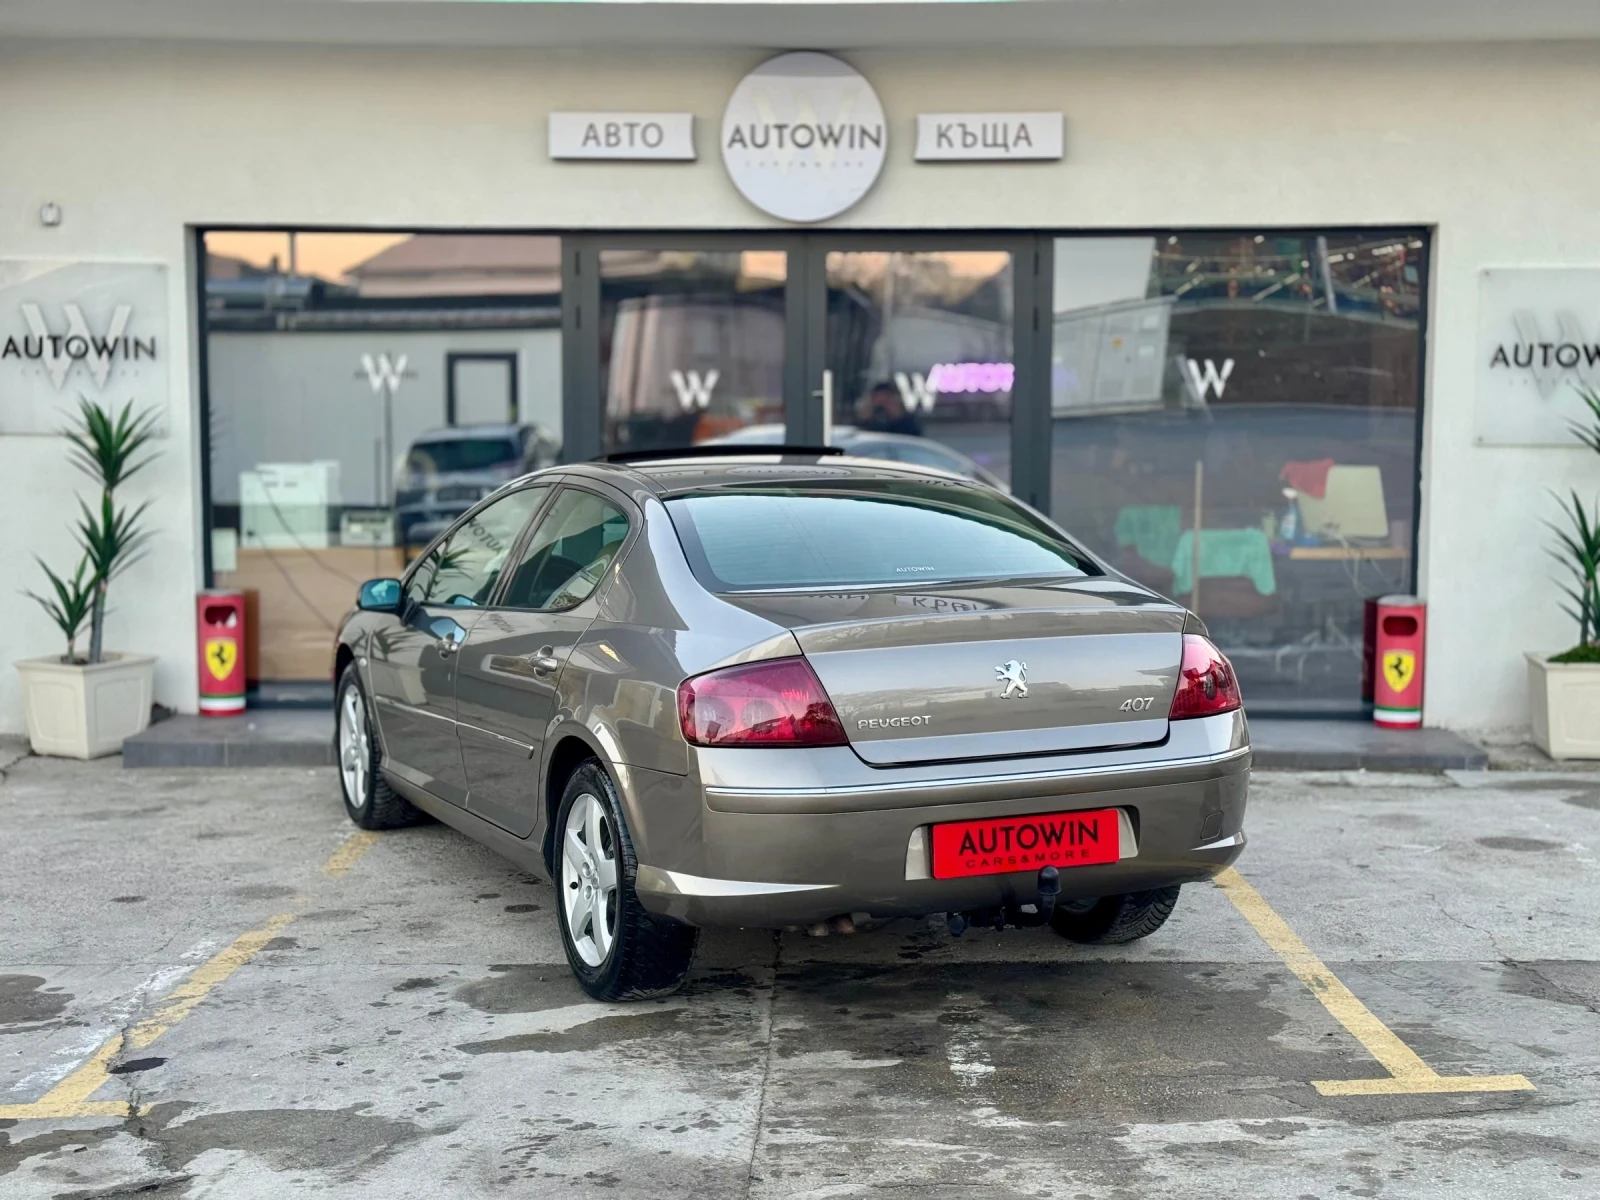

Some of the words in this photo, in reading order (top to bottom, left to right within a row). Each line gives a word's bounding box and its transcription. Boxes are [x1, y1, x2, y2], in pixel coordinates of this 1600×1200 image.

[581, 121, 665, 149] АВТО
[727, 123, 882, 149] AUTOWIN
[936, 121, 1033, 153] КЪЩА
[2, 335, 157, 360] AUTOWIN
[360, 352, 408, 395] W
[1187, 357, 1235, 400] W
[670, 369, 720, 410] W
[896, 565, 935, 573] AUTOWIN
[1118, 696, 1155, 712] 407
[857, 715, 932, 730] PEUGEOT
[958, 818, 1099, 856] AUTOWIN
[966, 848, 1090, 869] CARS&MORE
